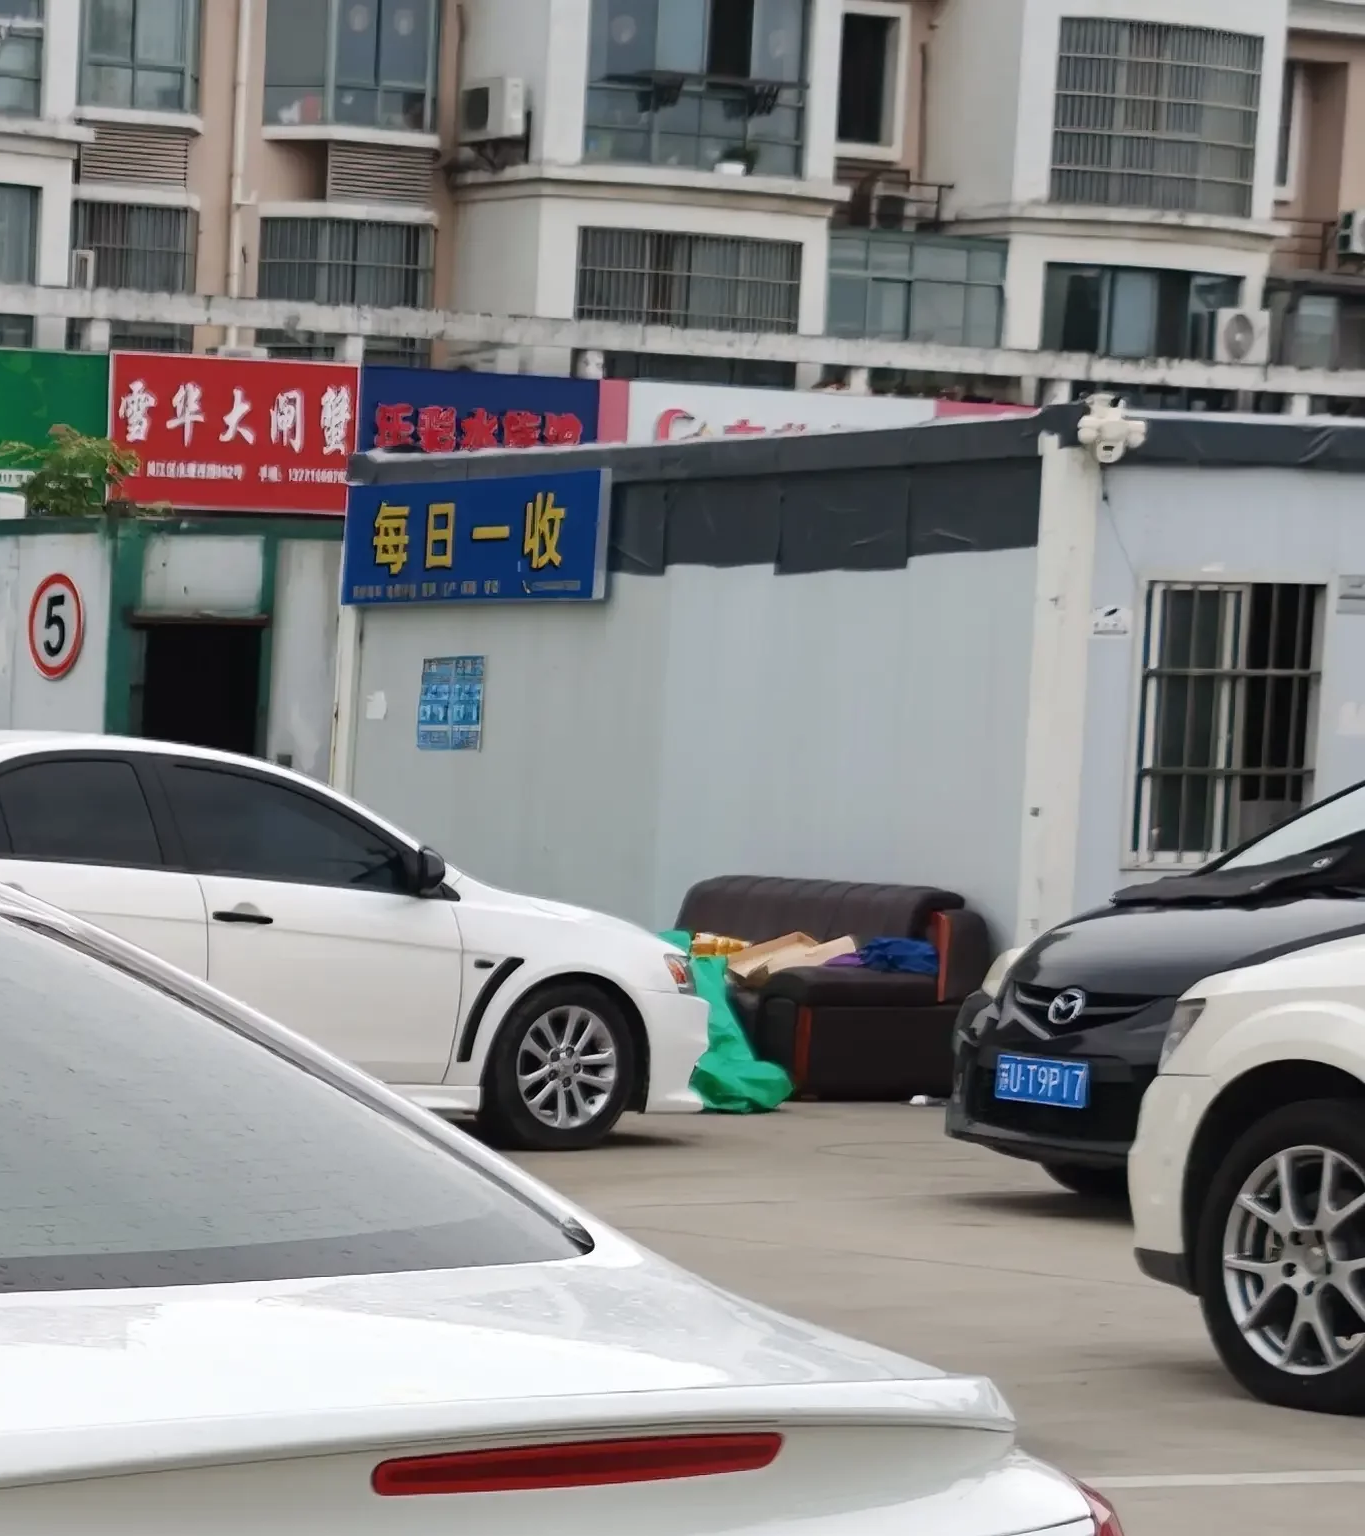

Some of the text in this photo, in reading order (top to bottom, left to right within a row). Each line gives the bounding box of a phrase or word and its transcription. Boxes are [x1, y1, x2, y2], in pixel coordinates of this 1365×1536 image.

[118, 379, 353, 456] 雪华大闸蟹
[372, 491, 567, 575] 每日一收
[42, 594, 67, 657] 5
